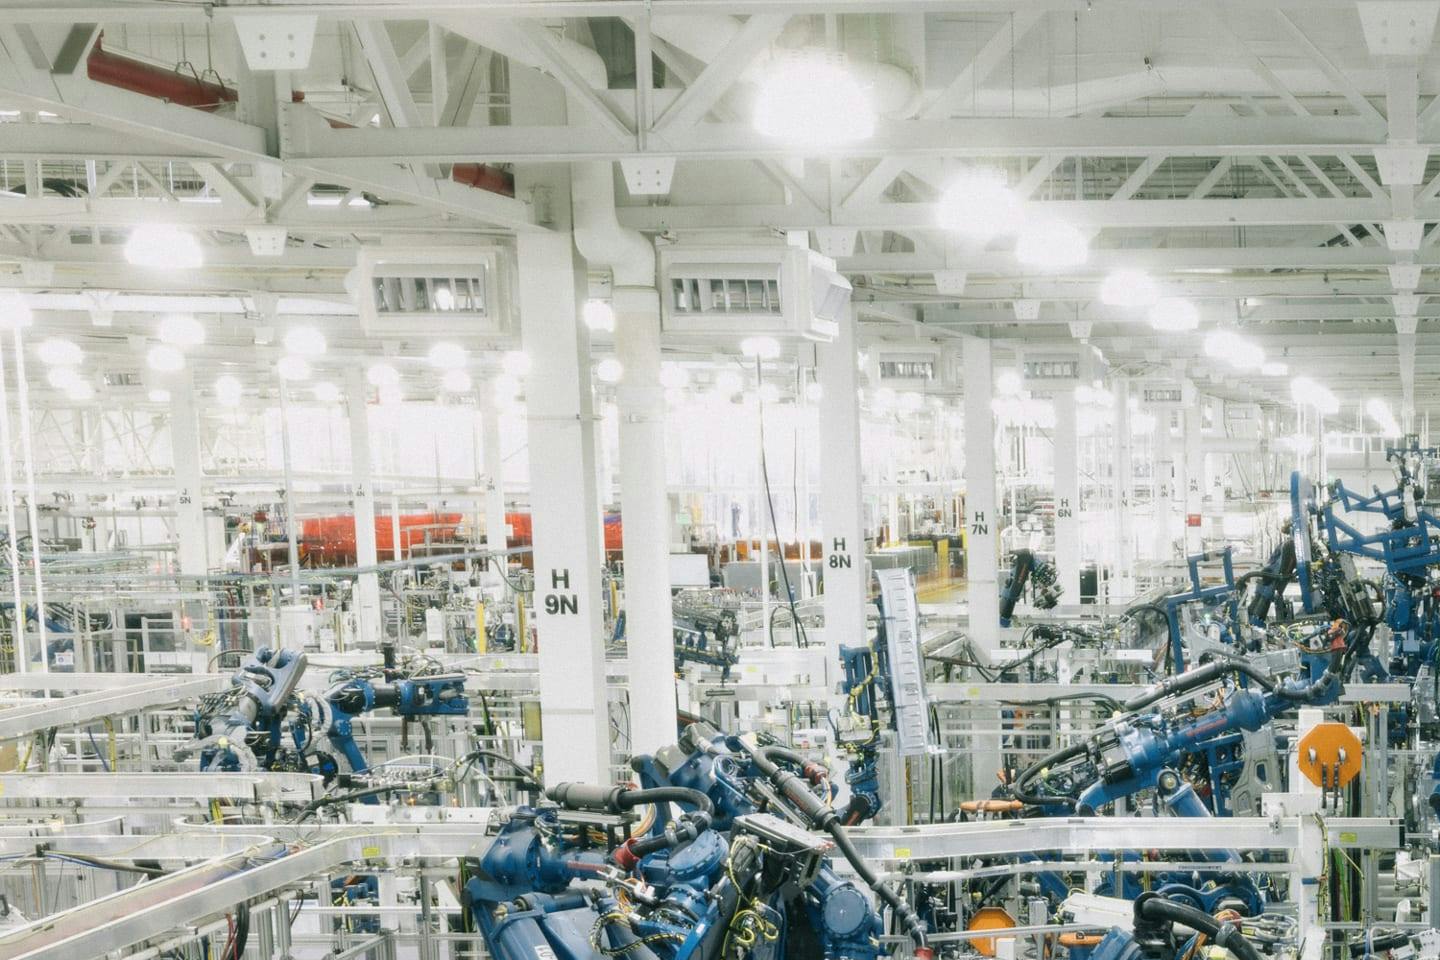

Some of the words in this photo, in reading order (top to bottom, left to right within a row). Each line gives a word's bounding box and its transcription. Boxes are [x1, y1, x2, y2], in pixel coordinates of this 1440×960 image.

[180, 496, 191, 504] 5N
[1061, 499, 1069, 507] H
[975, 511, 984, 521] H
[1058, 509, 1072, 517] 6N
[971, 524, 988, 535] 7N
[833, 537, 846, 551] H
[829, 554, 852, 569] 8N
[551, 568, 570, 589] H
[544, 594, 578, 615] 9N
